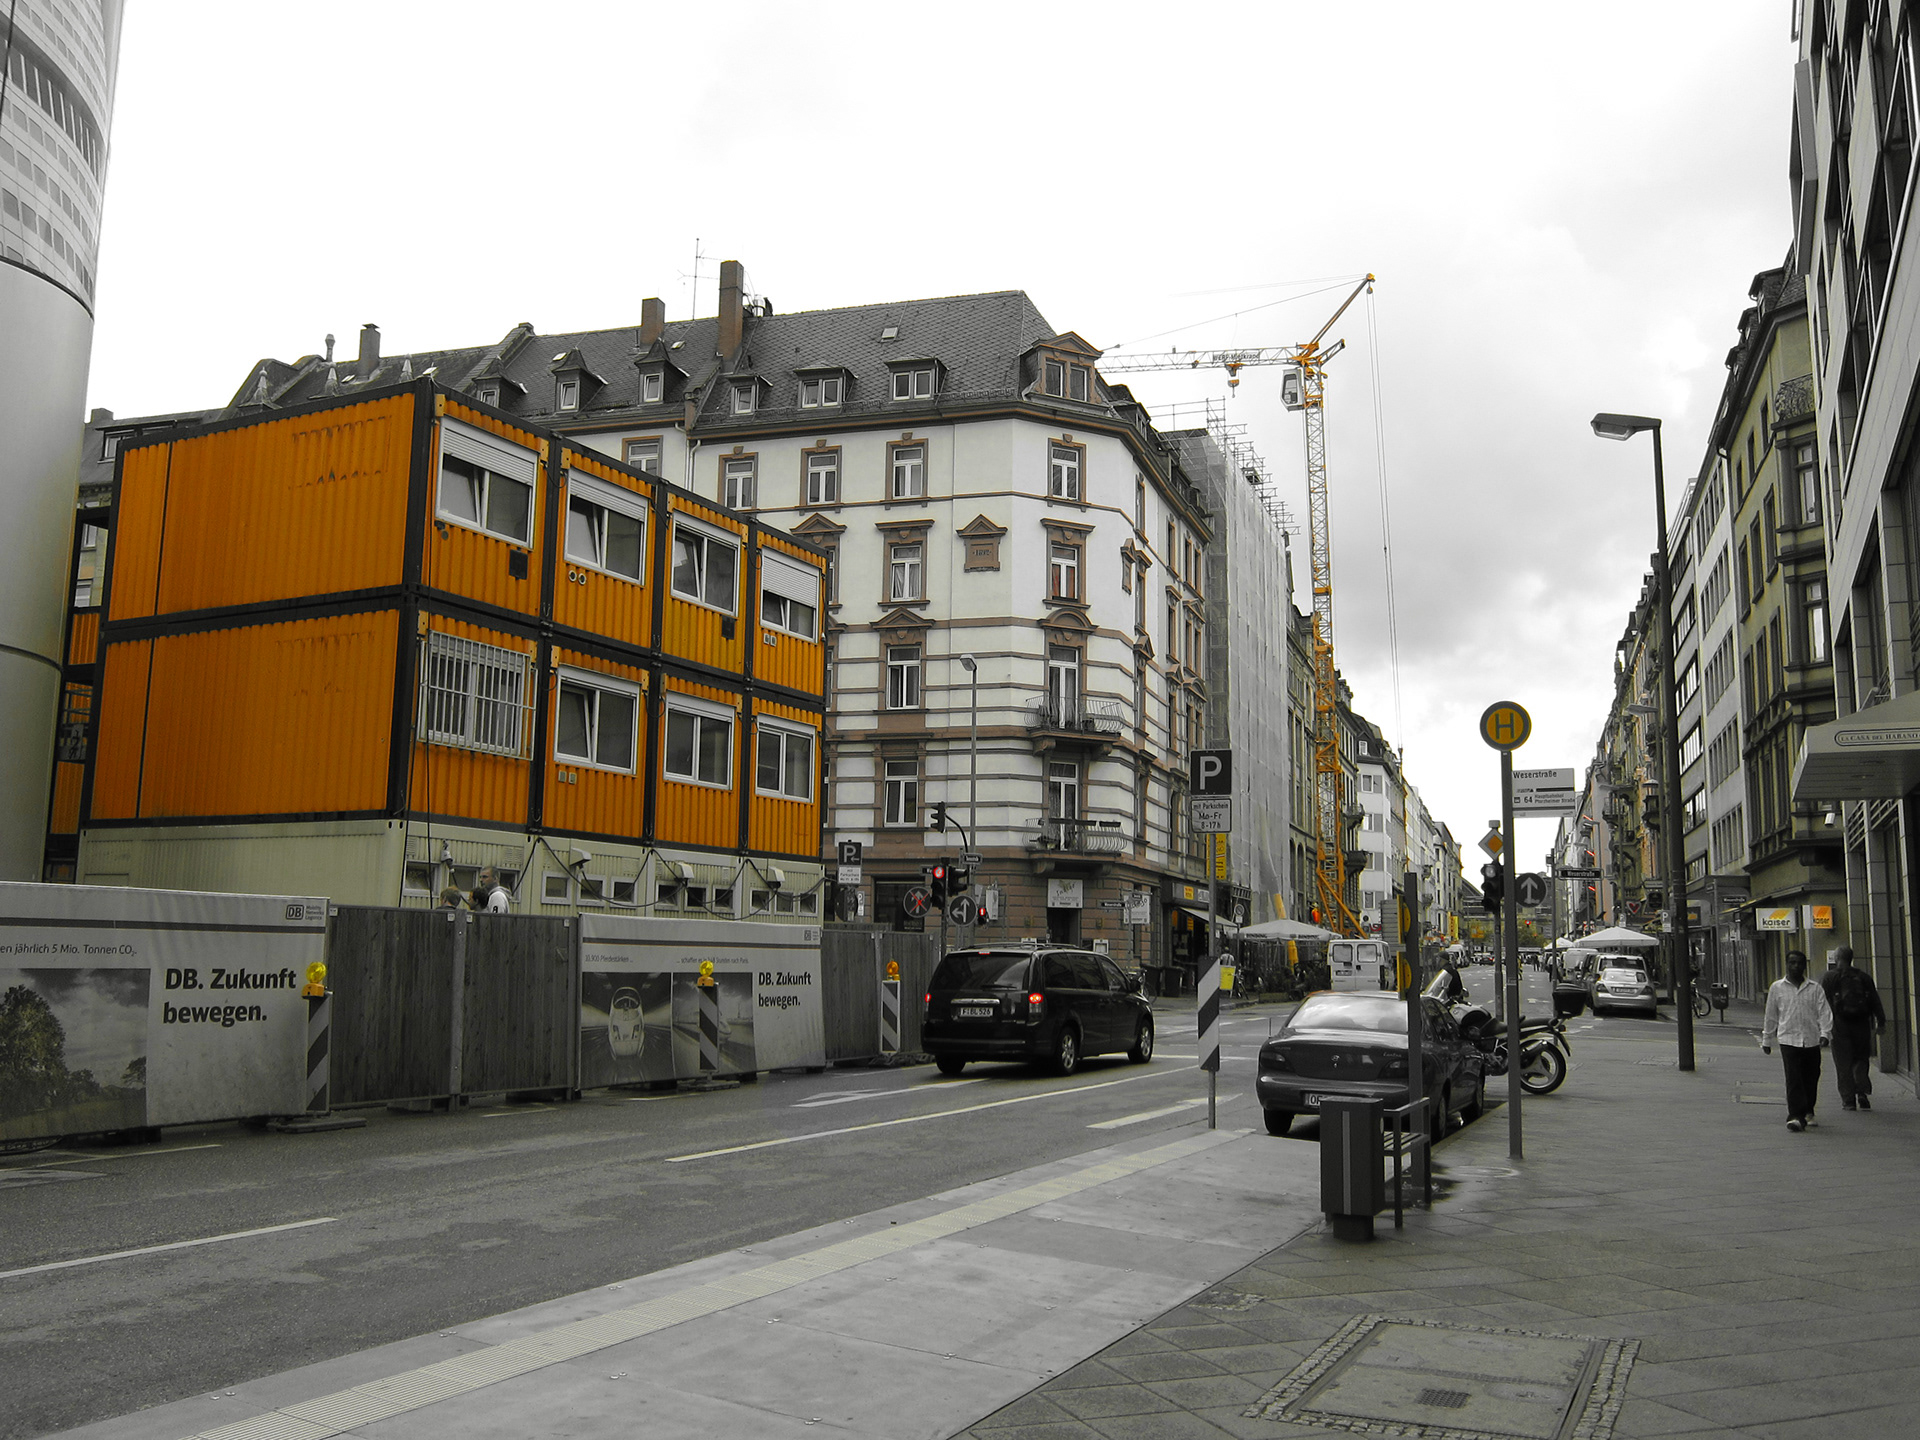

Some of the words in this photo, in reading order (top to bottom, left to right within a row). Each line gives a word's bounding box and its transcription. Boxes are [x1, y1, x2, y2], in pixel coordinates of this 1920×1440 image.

[1495, 712, 1515, 740] H
[1199, 755, 1223, 791] P
[1513, 770, 1558, 779] Weserstraße
[1202, 802, 1229, 810] Parkschein
[1523, 796, 1533, 804] 64
[1198, 811, 1222, 820] Mo-Fr
[1200, 821, 1221, 830] 8-17h
[843, 844, 857, 863] P
[287, 906, 302, 918] DB
[1762, 917, 1791, 926] kaiser
[14, 943, 50, 955] jährlich
[51, 943, 58, 954] 5
[60, 943, 80, 954] Mio.
[83, 944, 118, 955] Tonnen
[165, 968, 204, 990] DB.
[210, 967, 297, 990] Zukunft
[758, 971, 774, 986] DB.
[775, 971, 812, 986] Zukunft
[758, 992, 801, 1010] bewegen.
[163, 1001, 267, 1028] bewegen.
